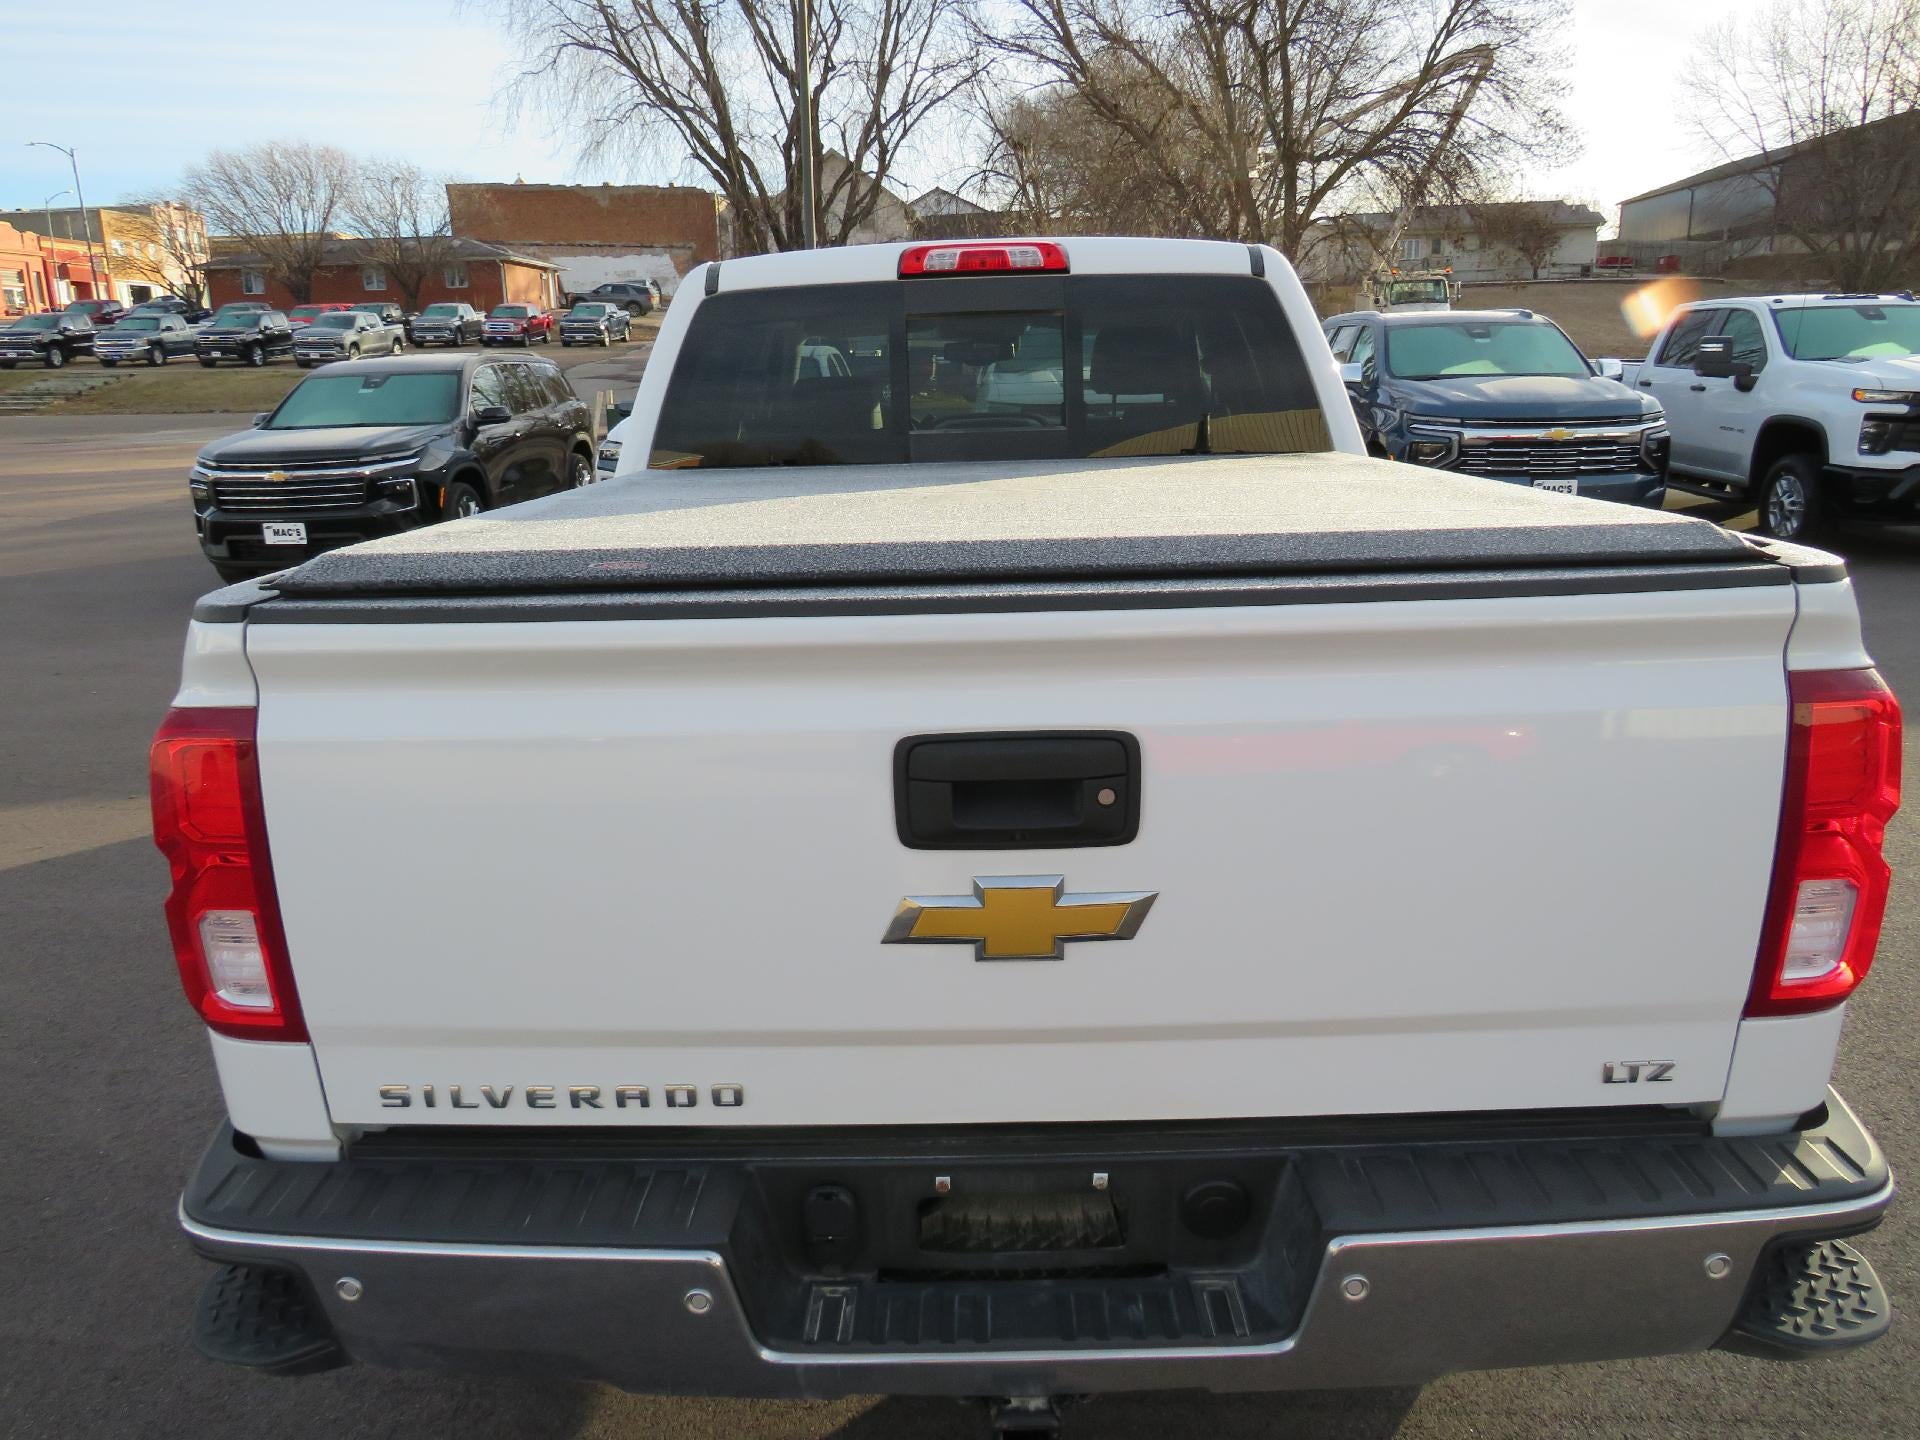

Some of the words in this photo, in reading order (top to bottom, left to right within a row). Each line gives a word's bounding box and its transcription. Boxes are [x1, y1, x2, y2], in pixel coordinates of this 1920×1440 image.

[272, 528, 301, 537] MAC'S
[1603, 1060, 1675, 1083] LTZ
[379, 1084, 744, 1108] SILVERADO
